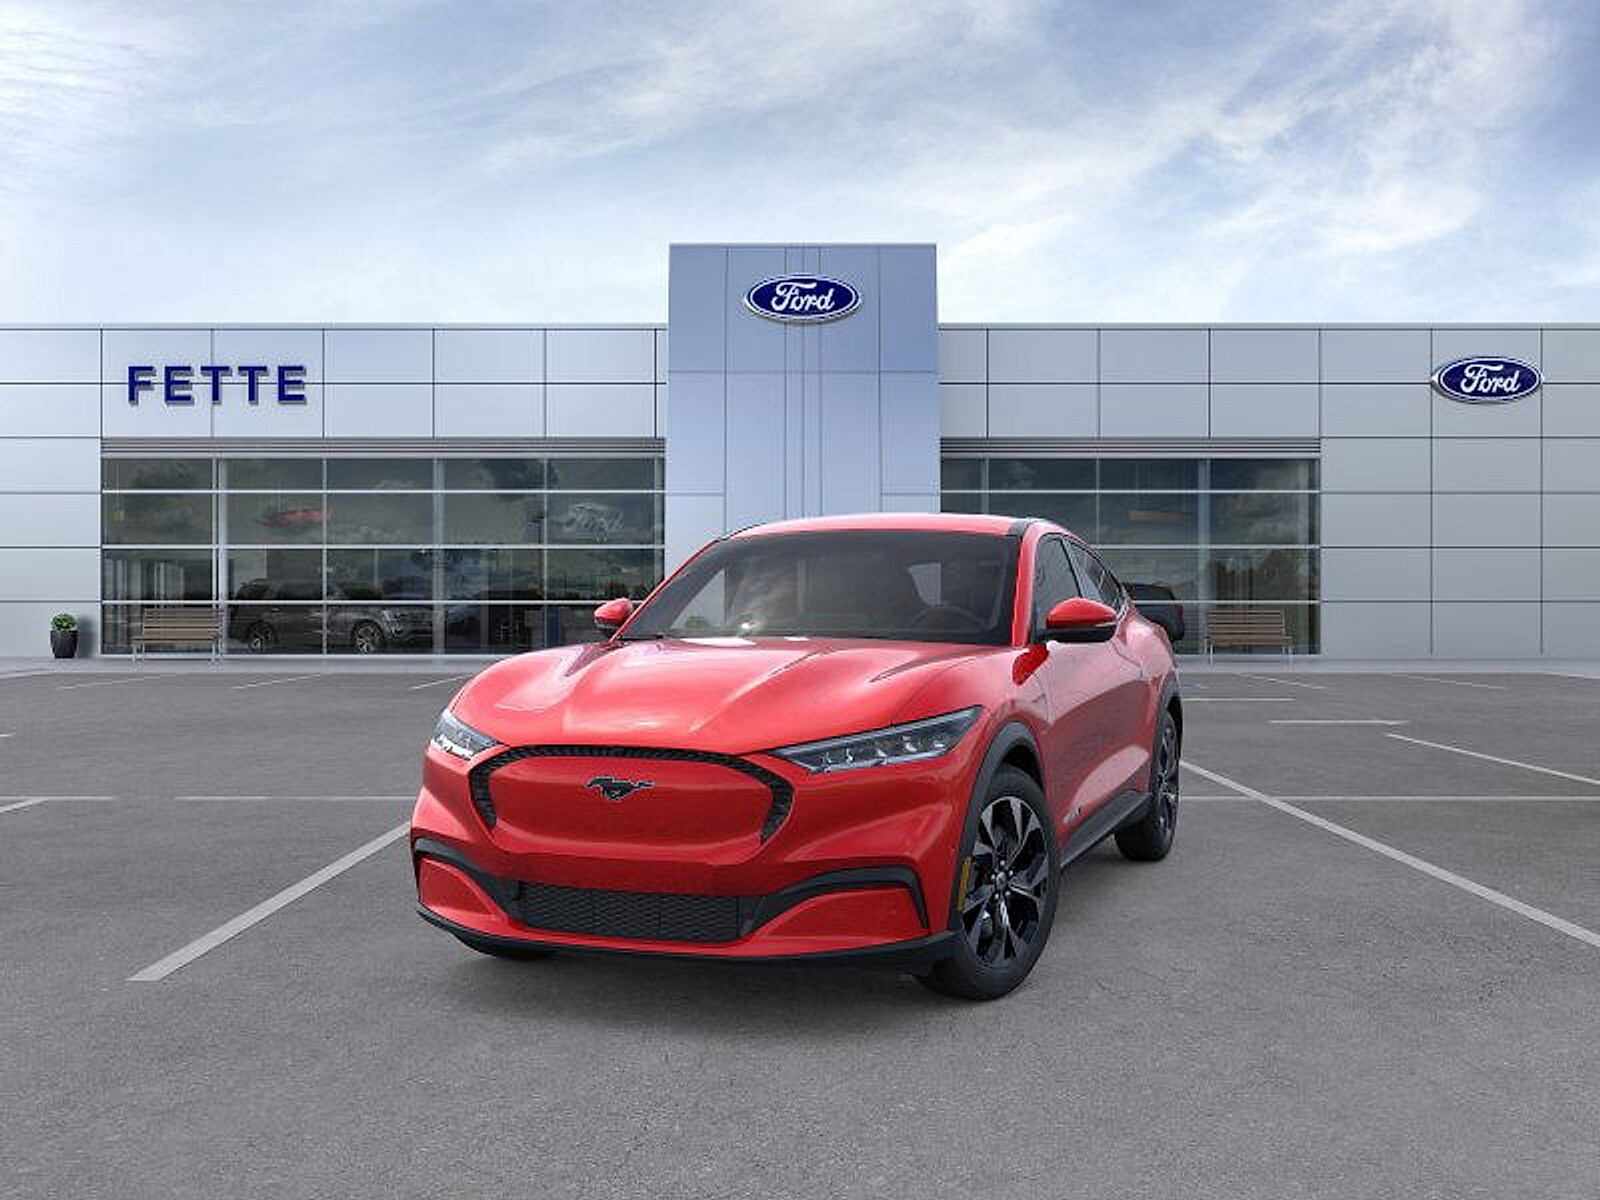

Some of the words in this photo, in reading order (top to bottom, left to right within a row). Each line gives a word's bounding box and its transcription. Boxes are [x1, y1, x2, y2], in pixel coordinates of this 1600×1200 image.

[771, 282, 835, 311] Ford
[128, 365, 307, 405] FETTE
[1461, 364, 1520, 393] Ford
